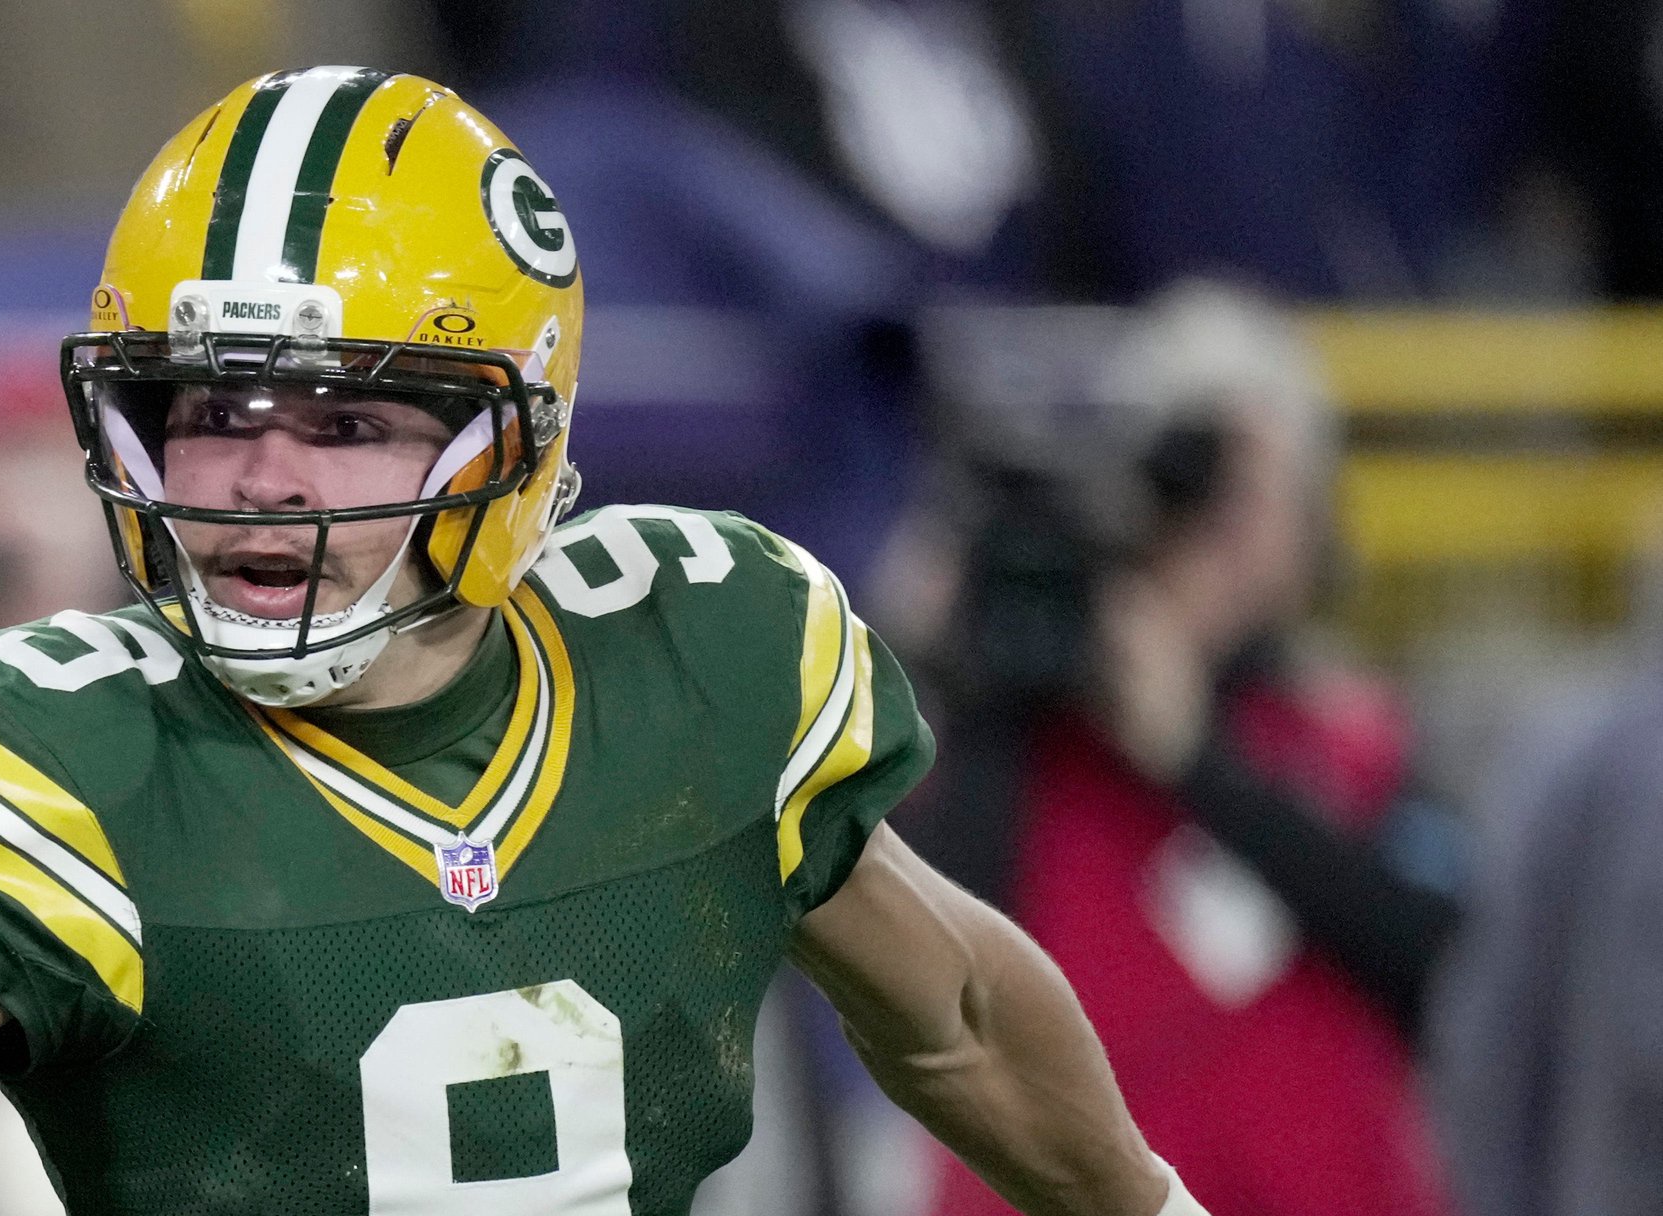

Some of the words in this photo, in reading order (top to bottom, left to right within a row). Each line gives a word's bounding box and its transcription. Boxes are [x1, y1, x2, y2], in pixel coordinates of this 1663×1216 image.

[490, 157, 576, 277] G
[222, 301, 281, 320] PACKERS
[419, 333, 484, 346] OAKLEY
[449, 867, 490, 897] NFL
